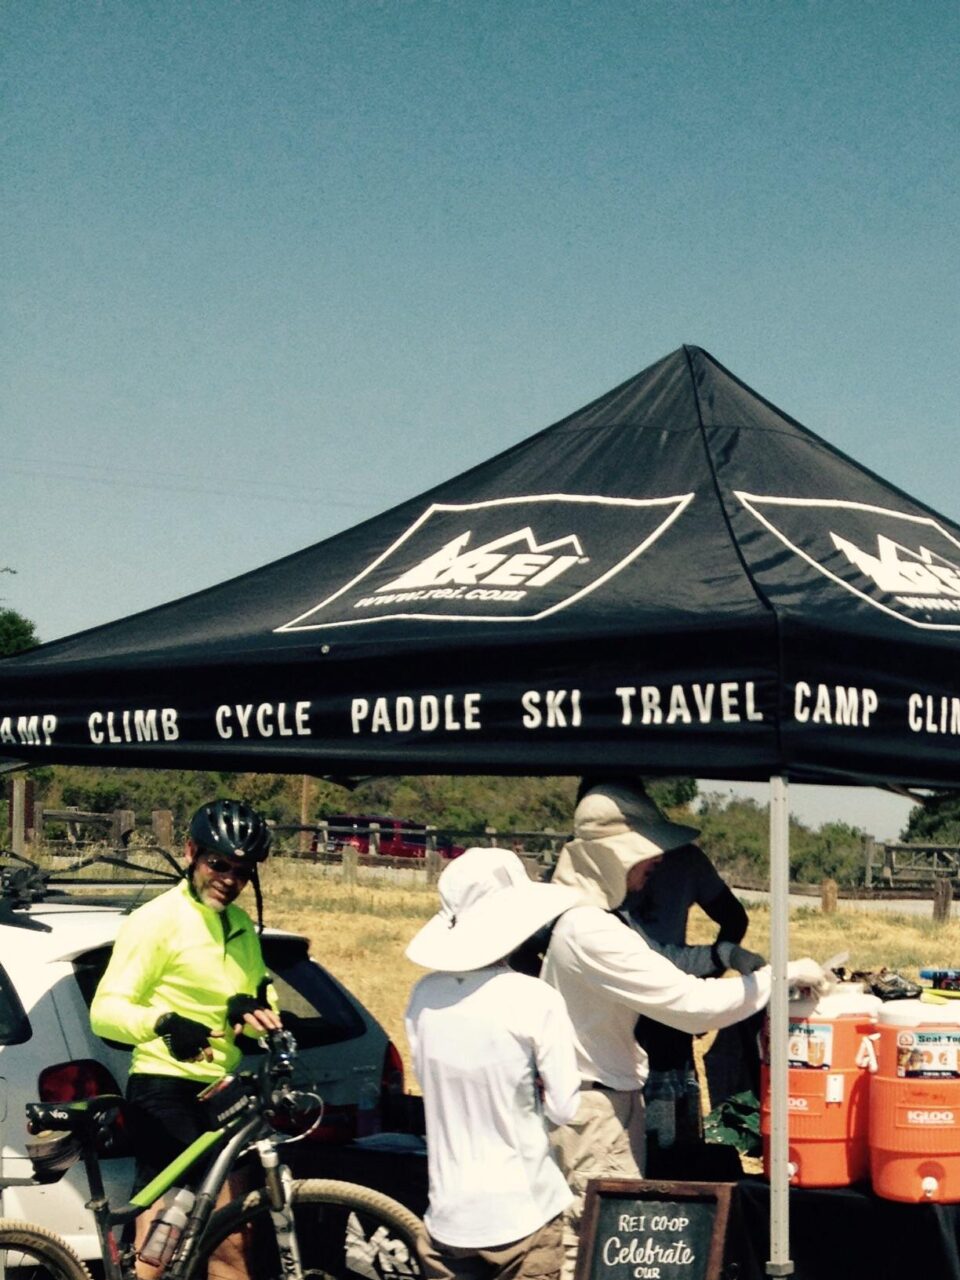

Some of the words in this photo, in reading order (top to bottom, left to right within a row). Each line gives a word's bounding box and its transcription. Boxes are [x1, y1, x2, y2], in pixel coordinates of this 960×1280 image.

[0, 715, 57, 746] AMP
[87, 708, 179, 744] CLIMB
[215, 701, 312, 739] CYCLE
[351, 693, 482, 734] PADDLE
[521, 690, 582, 728] SKI
[615, 682, 763, 726] TRAVEL
[794, 682, 879, 728] CAMP
[619, 1214, 646, 1232] REI
[603, 1237, 695, 1266] Celebrate
[633, 1266, 661, 1280] OUR
